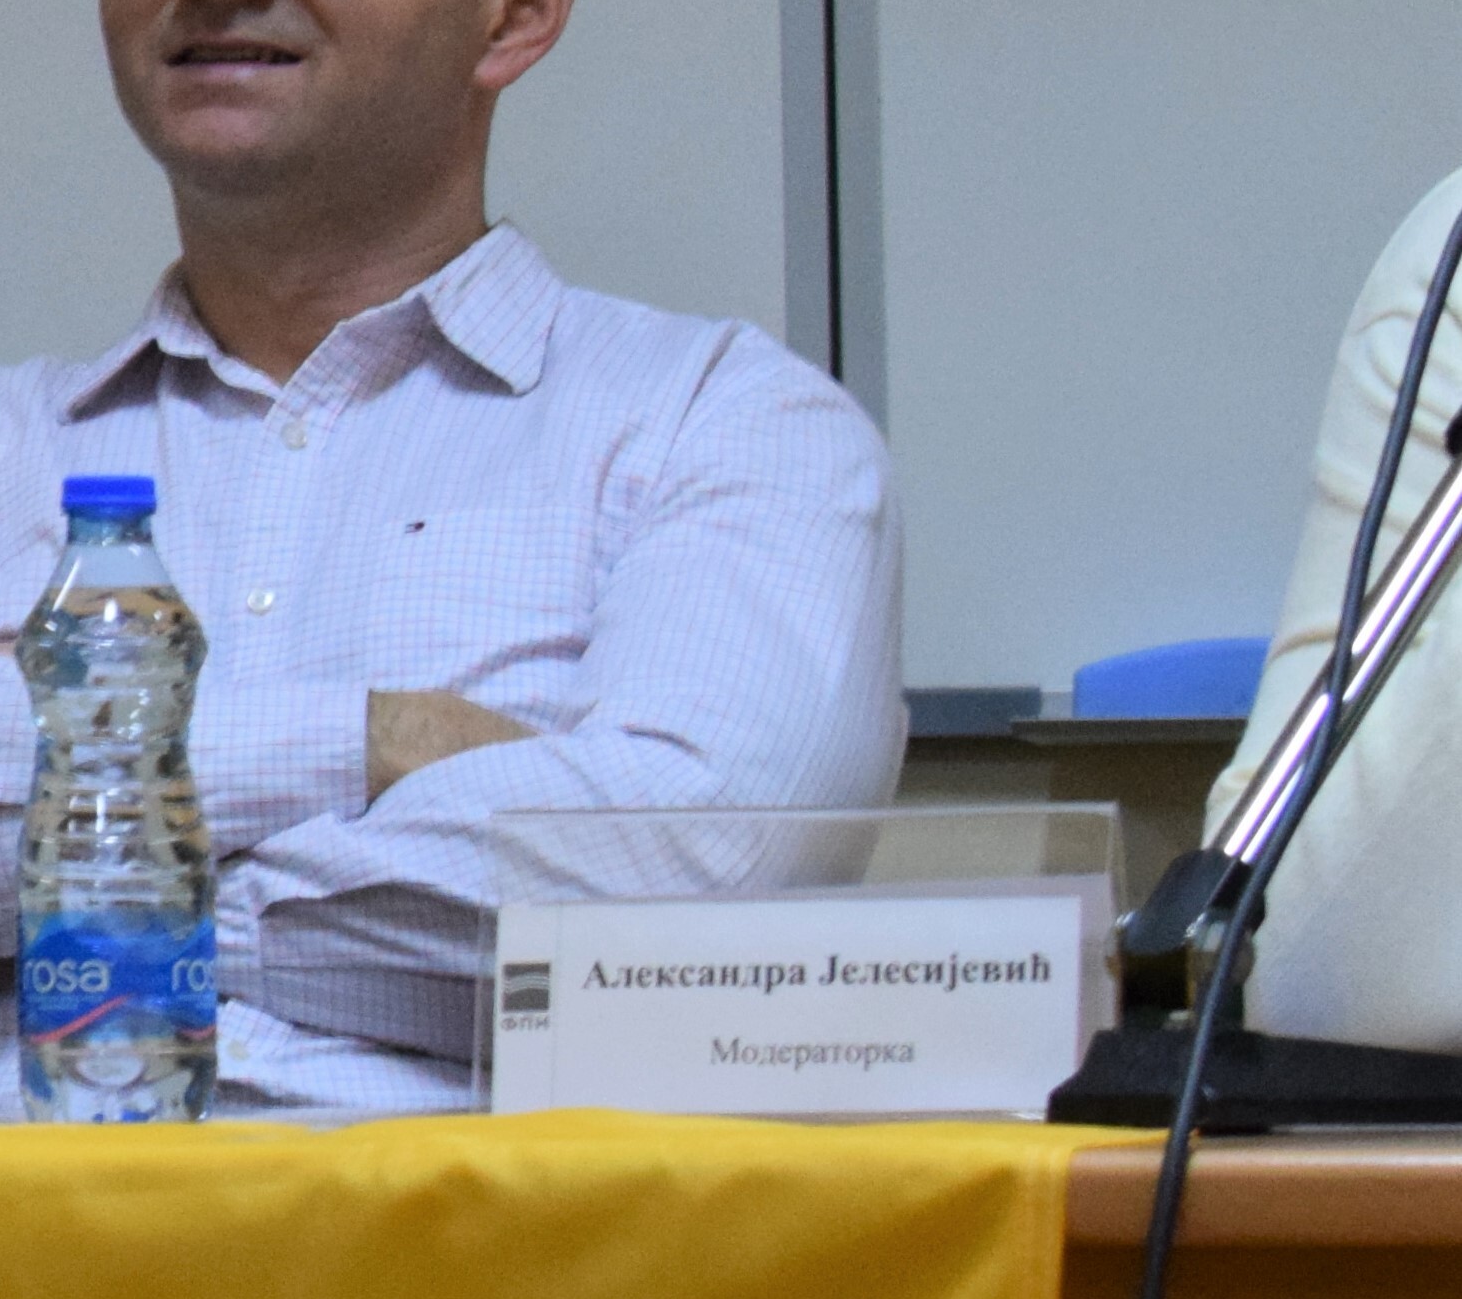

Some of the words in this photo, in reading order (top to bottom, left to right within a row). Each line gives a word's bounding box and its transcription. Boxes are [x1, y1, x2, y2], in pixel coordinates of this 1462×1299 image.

[23, 959, 110, 993] rosa
[582, 959, 806, 994] Александра
[819, 951, 1051, 992] Јелесијевић
[710, 1036, 915, 1071] Модераторка
